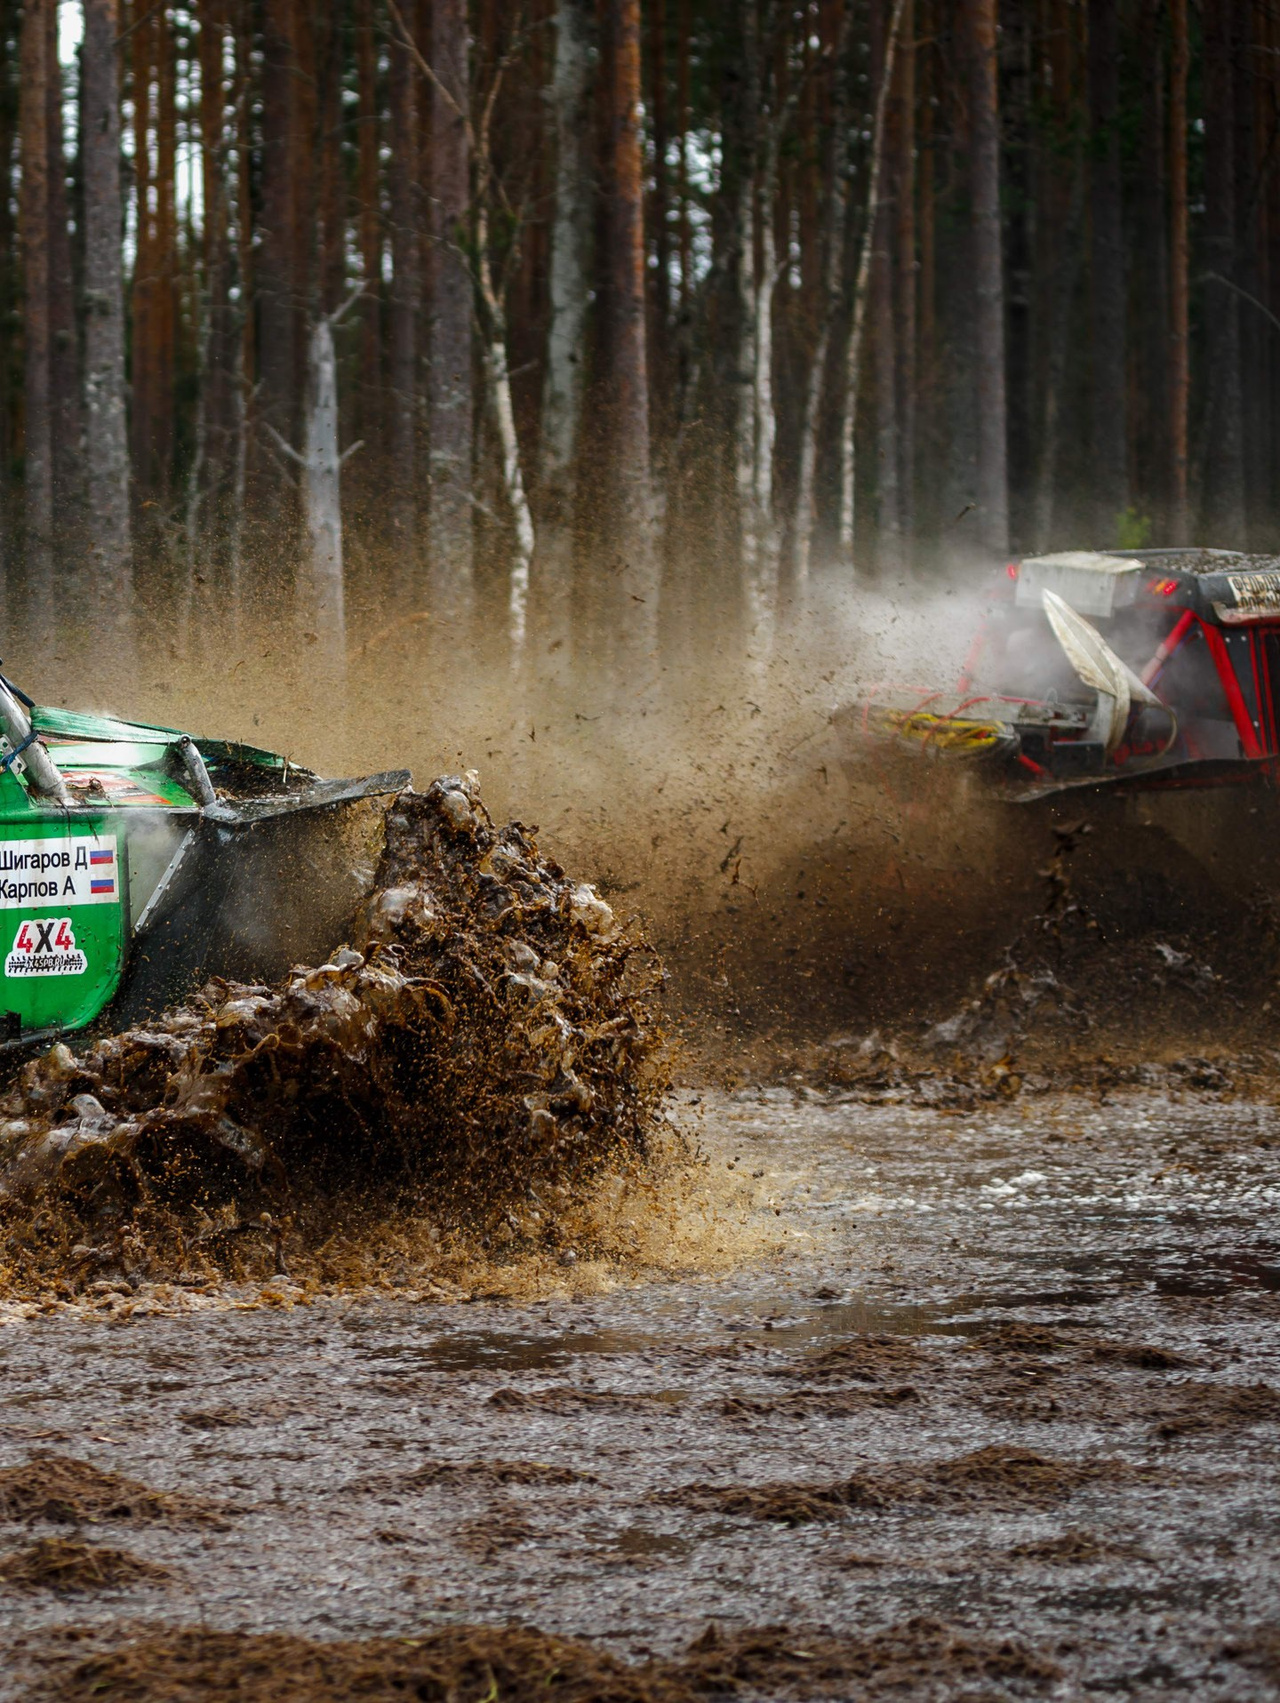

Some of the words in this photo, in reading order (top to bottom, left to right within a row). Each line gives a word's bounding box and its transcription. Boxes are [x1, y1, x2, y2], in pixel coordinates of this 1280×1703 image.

[74, 846, 88, 871] Д
[62, 875, 76, 896] А
[17, 921, 73, 953] 4X4
